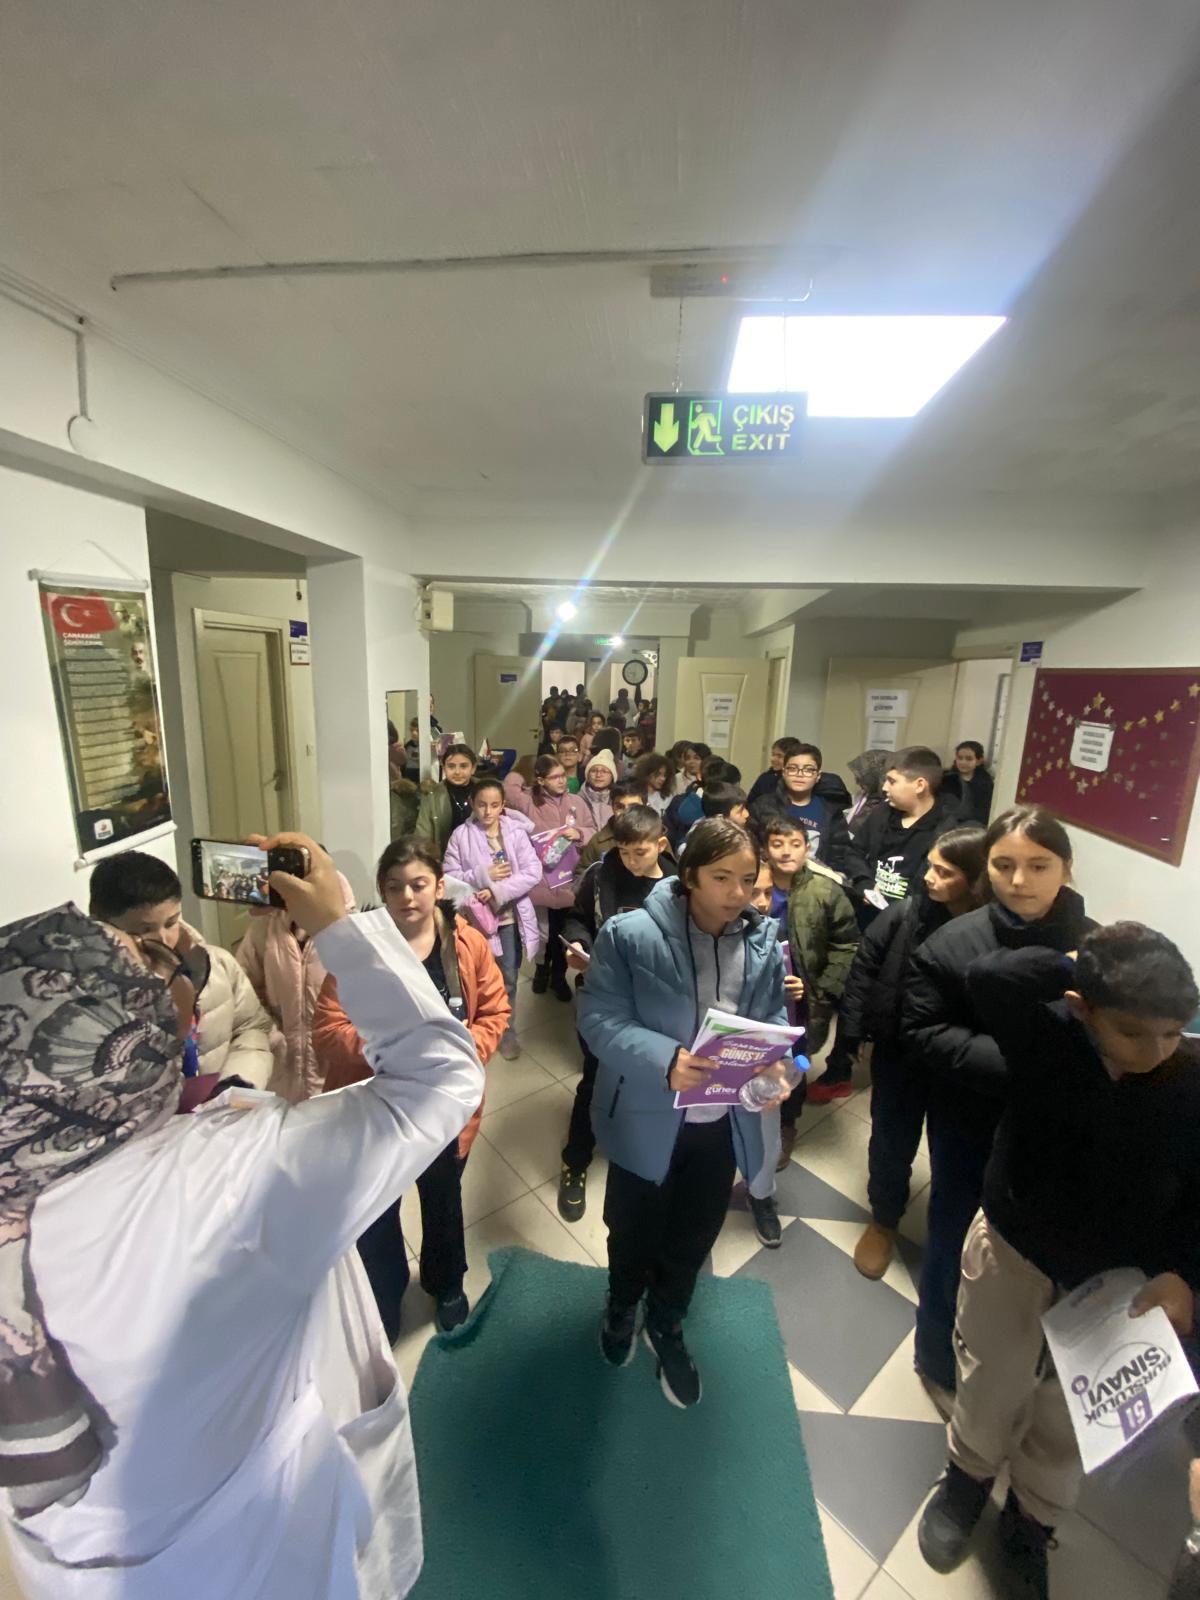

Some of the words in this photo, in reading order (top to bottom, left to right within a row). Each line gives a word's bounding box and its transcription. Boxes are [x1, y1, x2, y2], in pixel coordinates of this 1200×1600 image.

[731, 404, 795, 431] ÇIKIŞ
[731, 433, 791, 451] EXIT
[1085, 1353, 1172, 1425] BURSLULUK
[1086, 1346, 1162, 1407] SINAVI
